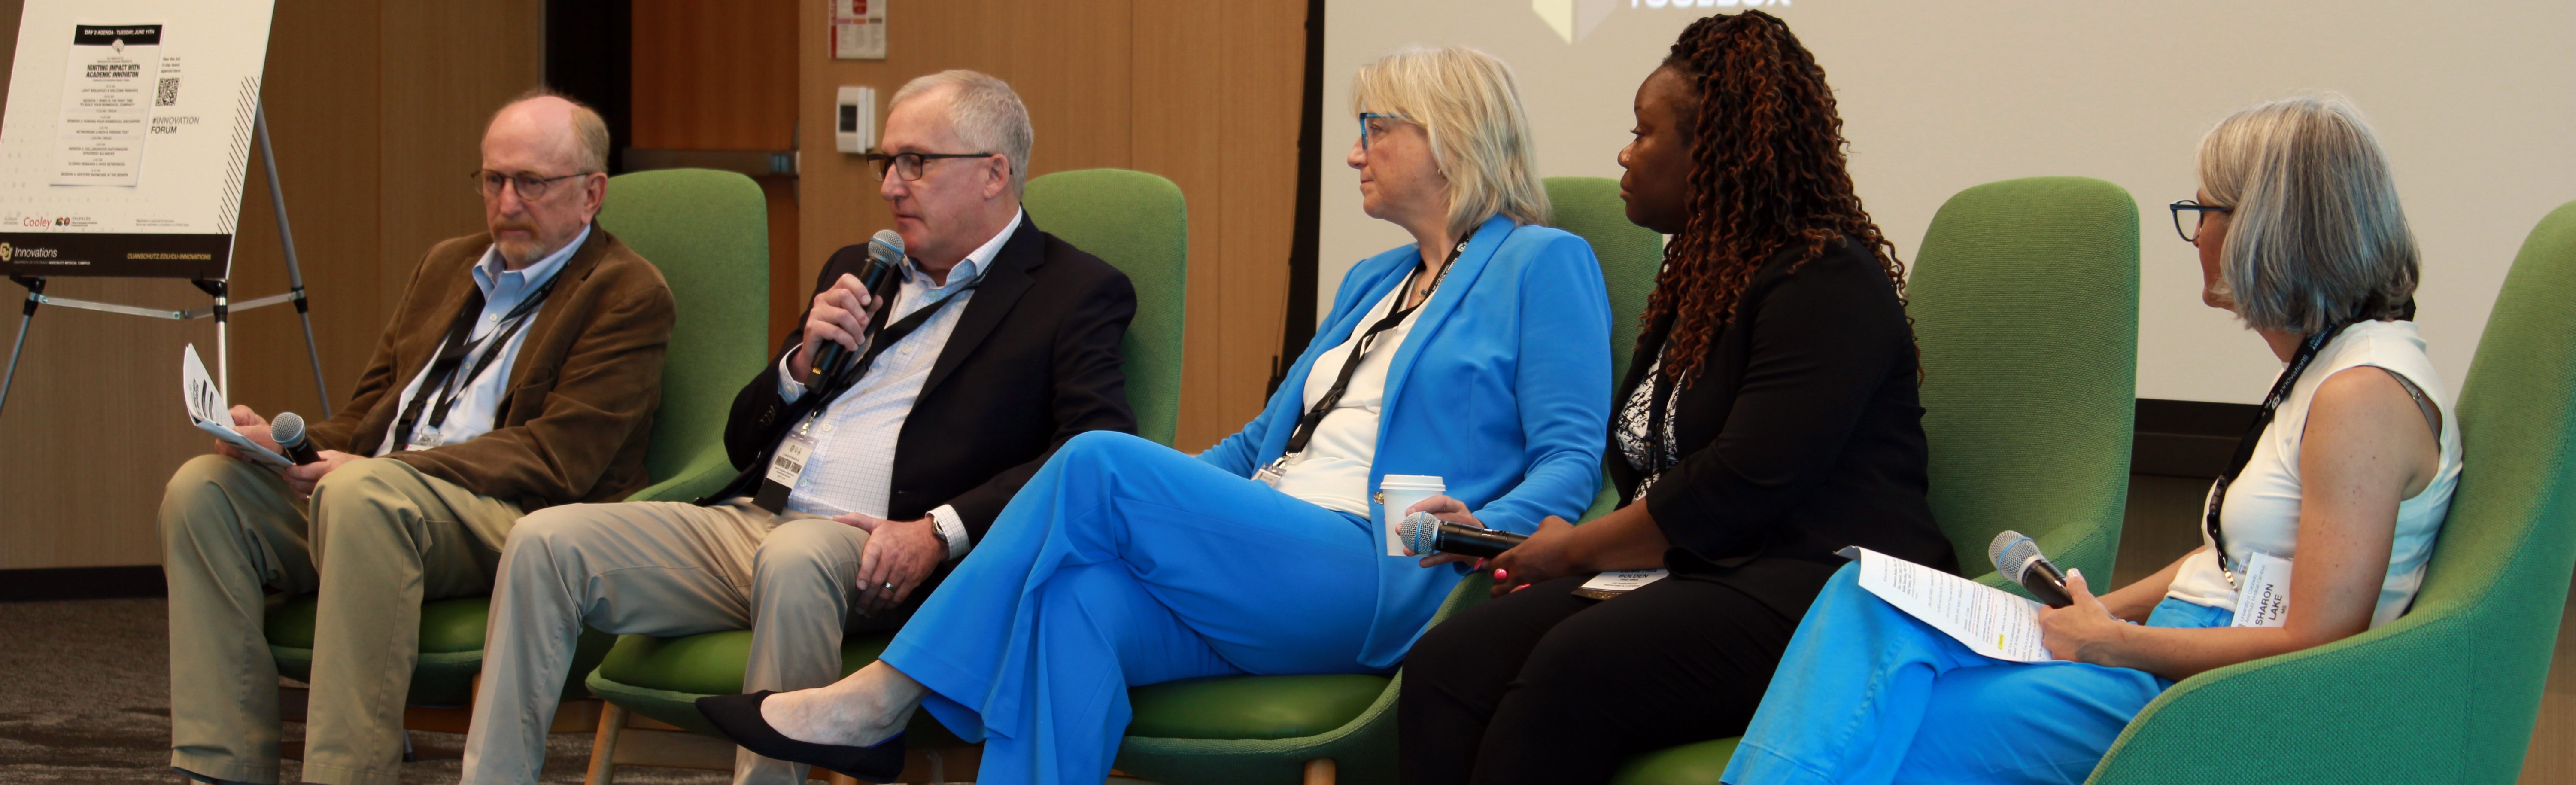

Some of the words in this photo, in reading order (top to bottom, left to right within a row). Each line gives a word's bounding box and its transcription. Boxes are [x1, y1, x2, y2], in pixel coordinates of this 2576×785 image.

[152, 116, 200, 125] #INNOVATION
[151, 126, 177, 134] FORUM
[24, 216, 52, 230] Cooley
[15, 247, 58, 258] Innovations
[2279, 354, 2309, 395] Innovations
[2255, 583, 2274, 626] SHARON
[2268, 594, 2282, 621] LAKE
